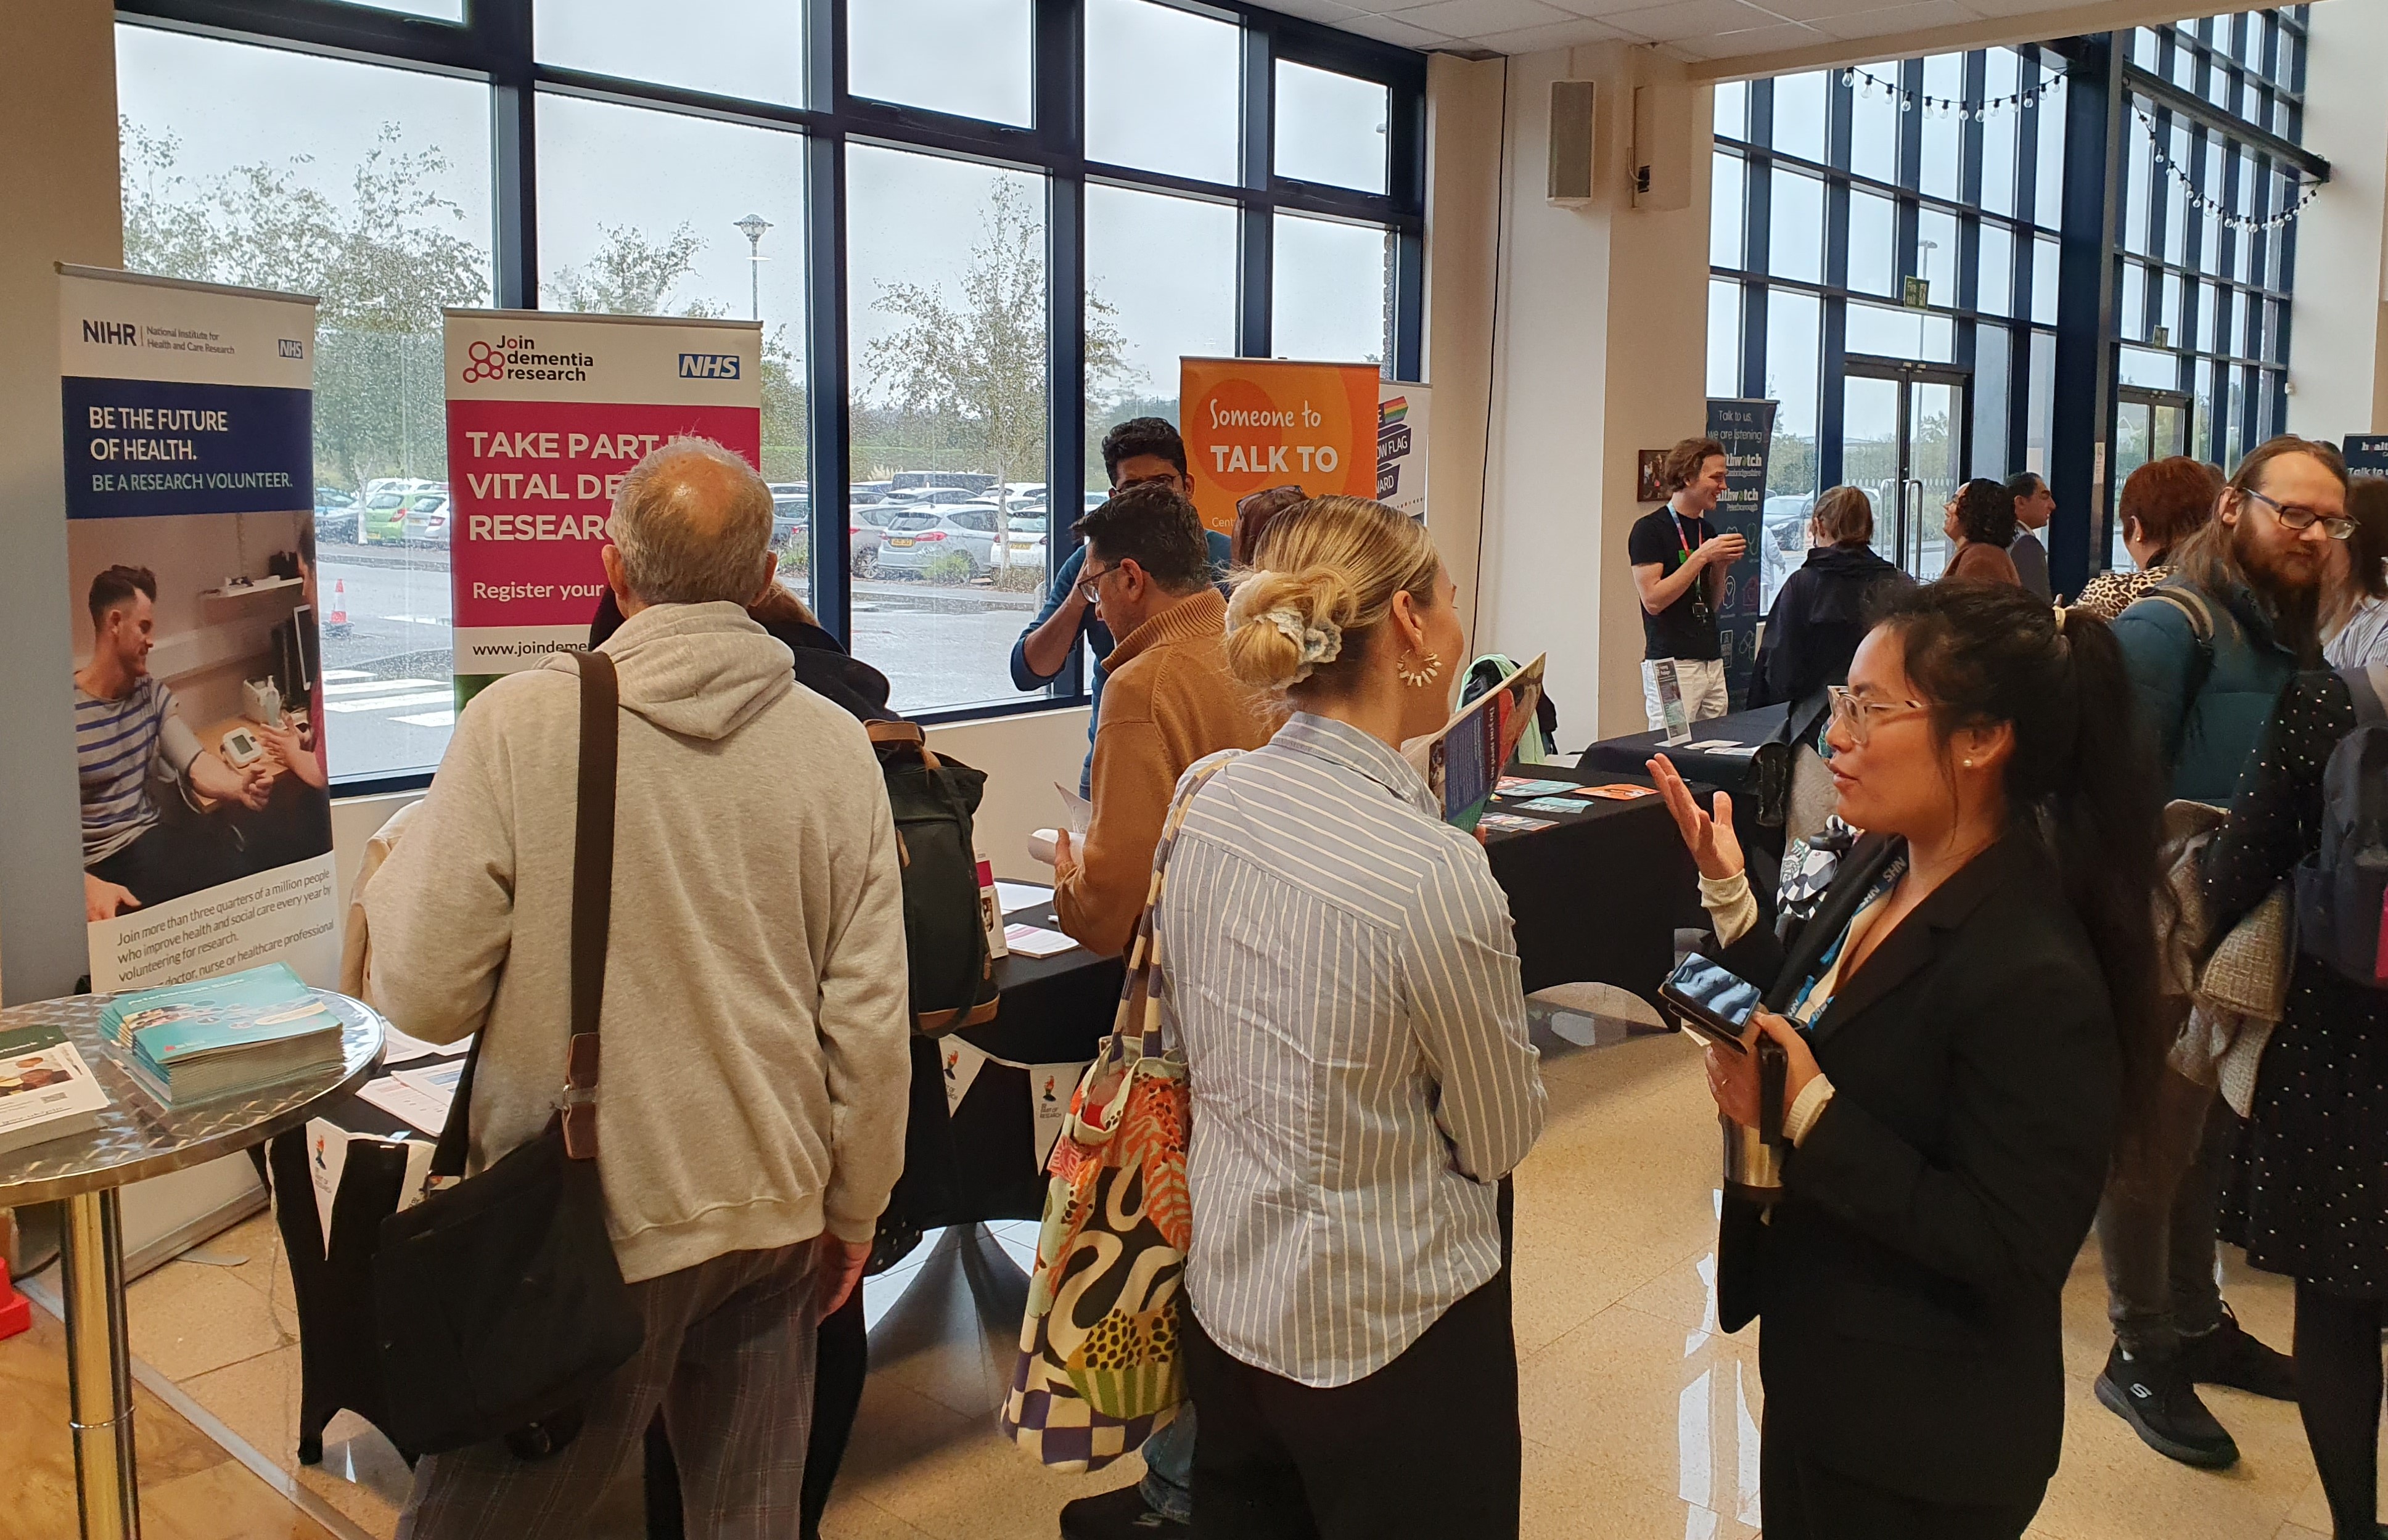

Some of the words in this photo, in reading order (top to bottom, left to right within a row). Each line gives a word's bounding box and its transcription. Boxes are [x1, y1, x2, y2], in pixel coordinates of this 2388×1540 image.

[83, 319, 137, 346] NIHR
[146, 326, 177, 338] National
[178, 329, 208, 340] Institute
[209, 332, 220, 341] for
[496, 335, 535, 350] Join
[147, 339, 171, 350] Health
[173, 341, 185, 351] and
[187, 342, 203, 352] Care
[205, 343, 235, 354] Research
[280, 340, 302, 358] NHS
[507, 351, 594, 367] dementia
[680, 354, 738, 379] NHS
[507, 367, 586, 382] research
[89, 406, 116, 429] BE
[118, 408, 154, 430] THE
[158, 409, 228, 432] FUTURE
[1210, 399, 1295, 429] Someone
[1301, 399, 1321, 428] to
[1718, 410, 1733, 422] Talk
[1734, 411, 1741, 421] to
[466, 432, 559, 459] TAKE
[568, 433, 659, 459] PART
[1388, 435, 1408, 454] FLAG
[1720, 430, 1733, 440] are
[1734, 428, 1763, 443] listening
[90, 438, 120, 461] OF
[124, 439, 197, 461] HEALTH.
[1210, 445, 1289, 473] TALK
[1297, 445, 1338, 473] TO
[92, 473, 114, 492] BE
[117, 475, 129, 490] A
[131, 473, 203, 491] RESEARCH
[207, 472, 293, 488] VOLUNTEER.
[467, 473, 569, 499] VITAL
[473, 581, 554, 602] Register
[559, 584, 604, 601] your
[473, 641, 589, 657] www.joindeme
[117, 932, 141, 946] Join
[141, 921, 166, 939] more
[166, 914, 189, 930] than
[189, 906, 215, 922] three
[216, 894, 254, 914] quarters
[255, 888, 265, 900] of
[265, 888, 271, 898] a
[271, 879, 303, 896] million
[304, 869, 330, 888] people
[118, 948, 142, 964] who
[144, 936, 181, 957] improve
[182, 923, 212, 943] health
[213, 917, 231, 932] and
[231, 909, 256, 926] social
[256, 902, 276, 917] care
[276, 895, 302, 911] every
[303, 888, 322, 904] year
[322, 884, 332, 896] by
[118, 952, 181, 982] volunteering
[182, 946, 196, 960] for
[197, 931, 239, 955] research.
[165, 971, 198, 987] doctor,
[199, 960, 225, 977] nurse
[226, 957, 236, 967] or
[237, 938, 283, 963] healthcare
[283, 918, 335, 948] professional
